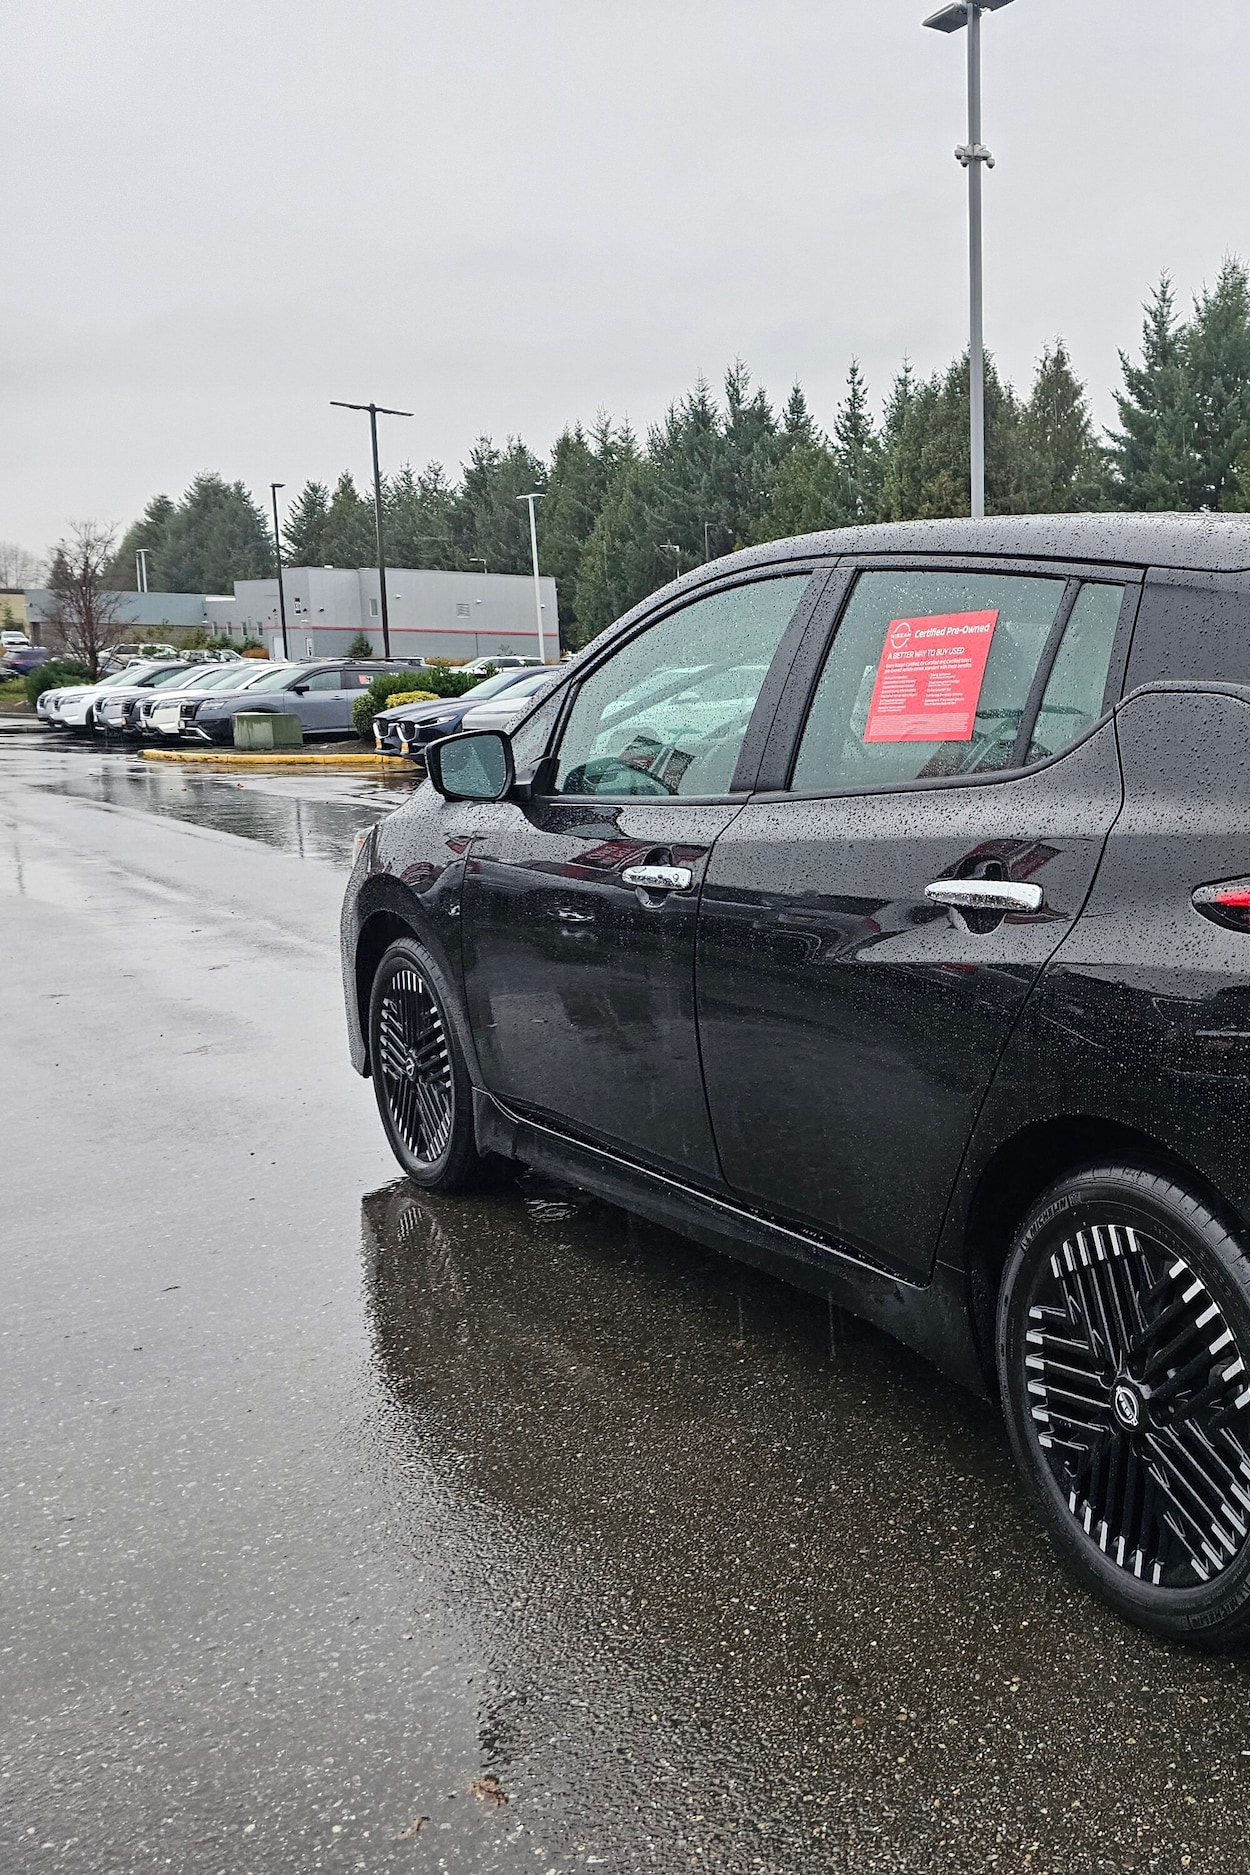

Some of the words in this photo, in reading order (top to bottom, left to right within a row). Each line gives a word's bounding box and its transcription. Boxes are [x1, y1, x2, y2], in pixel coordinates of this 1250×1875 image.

[914, 627, 947, 639] Certified
[946, 623, 991, 636] Pre-Owned
[892, 650, 915, 659] BETTER
[914, 649, 928, 658] WAY
[927, 648, 936, 657] TO
[936, 647, 949, 656] BUY
[948, 646, 965, 655] USED
[1029, 1196, 1070, 1237] MICHELIN
